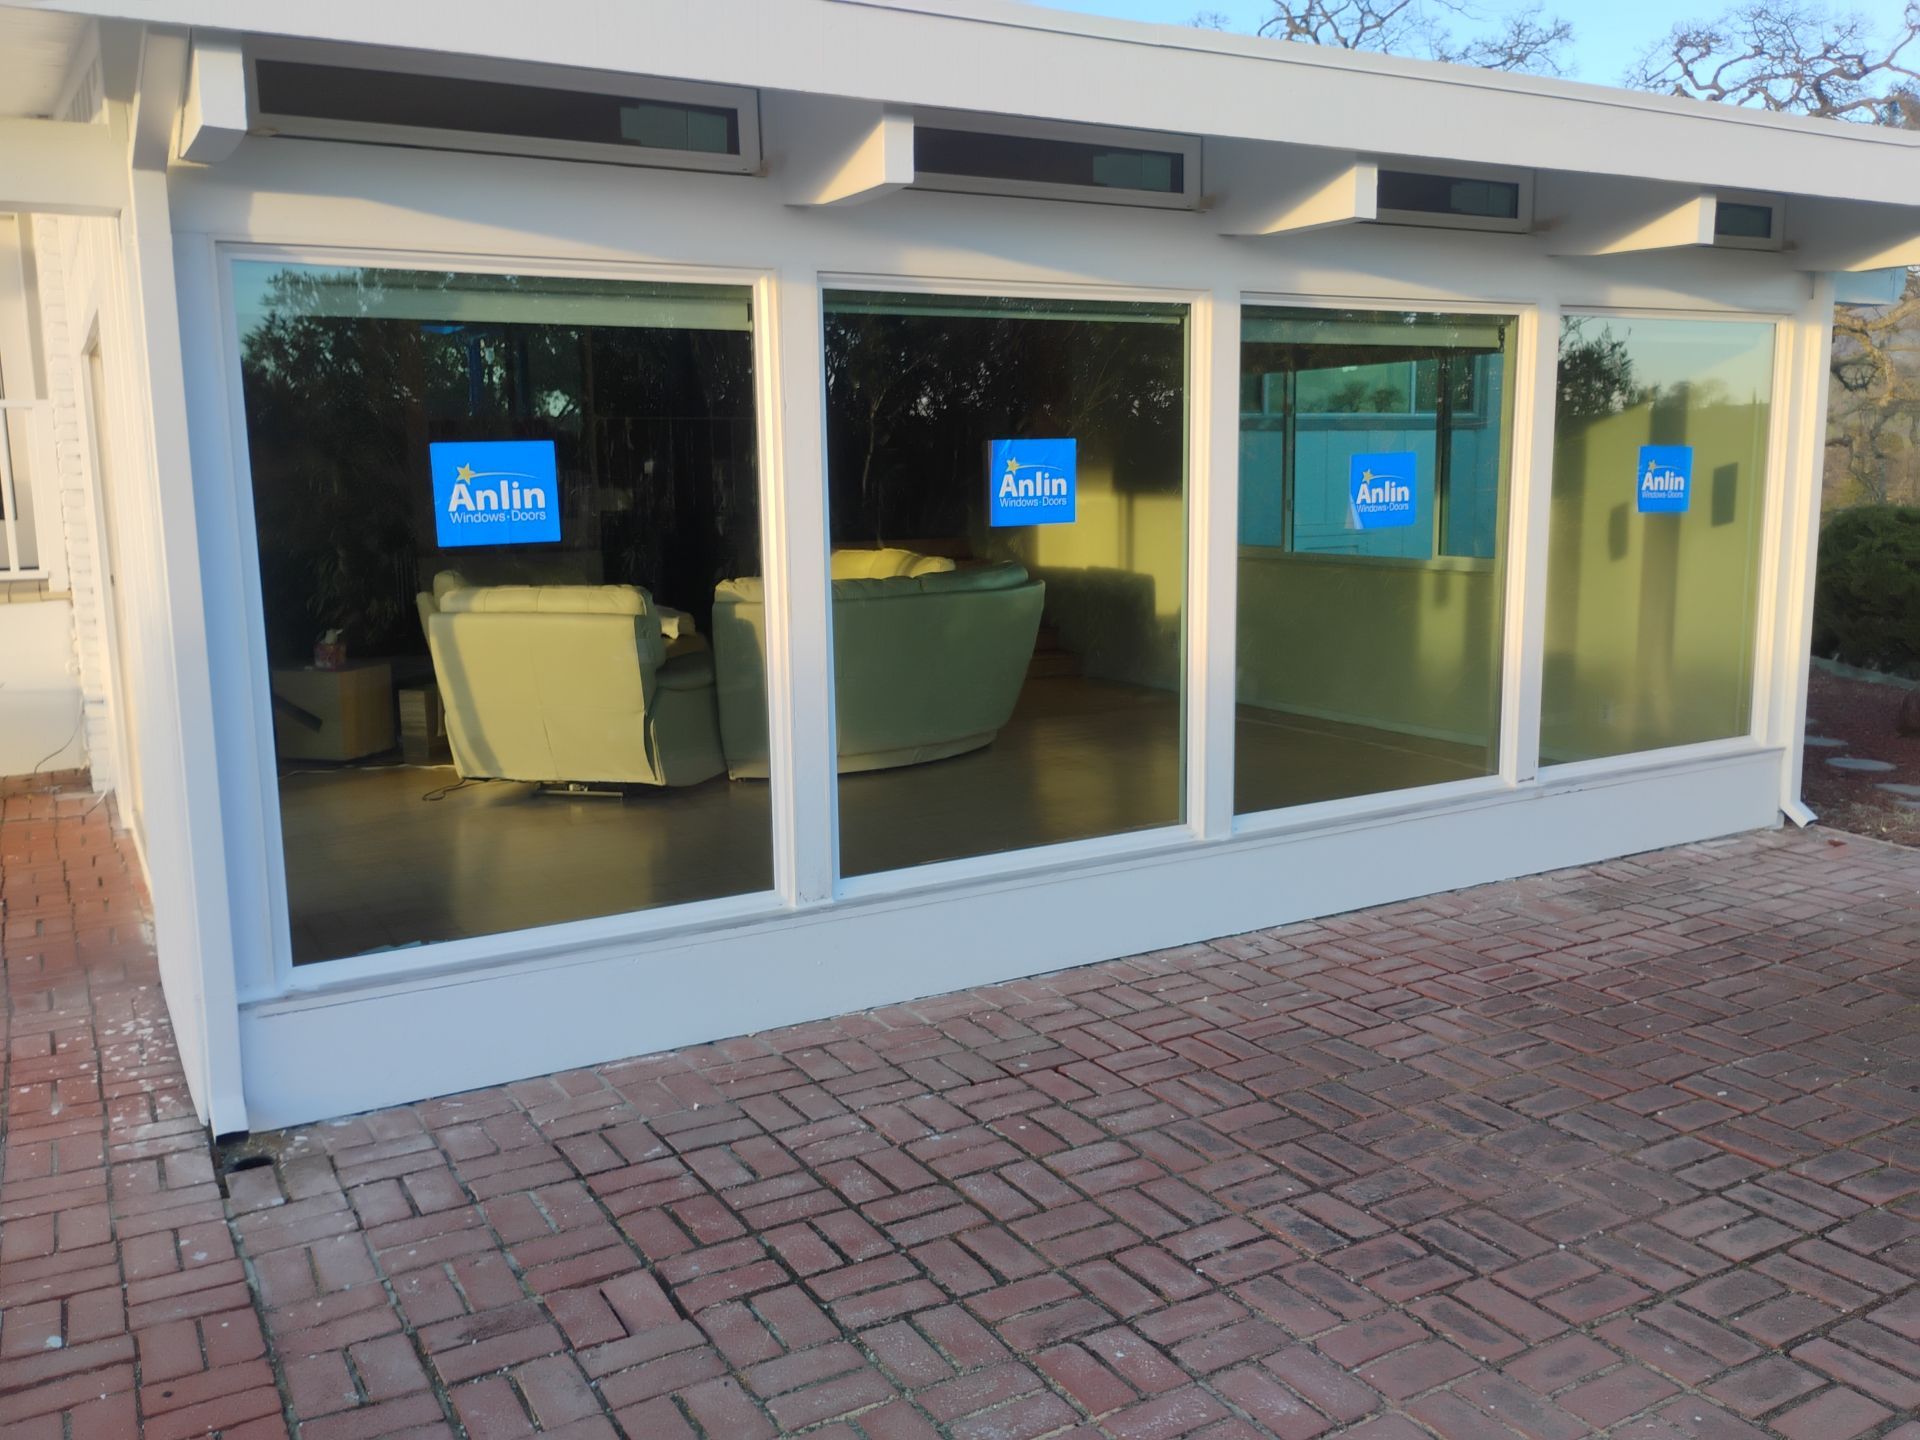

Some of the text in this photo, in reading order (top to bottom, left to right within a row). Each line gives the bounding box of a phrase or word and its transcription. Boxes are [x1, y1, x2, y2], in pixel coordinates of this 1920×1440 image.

[999, 471, 1067, 497] Anlin
[1356, 480, 1409, 504] Anlin
[1642, 470, 1685, 491] Anlin
[448, 480, 545, 512] Anlin
